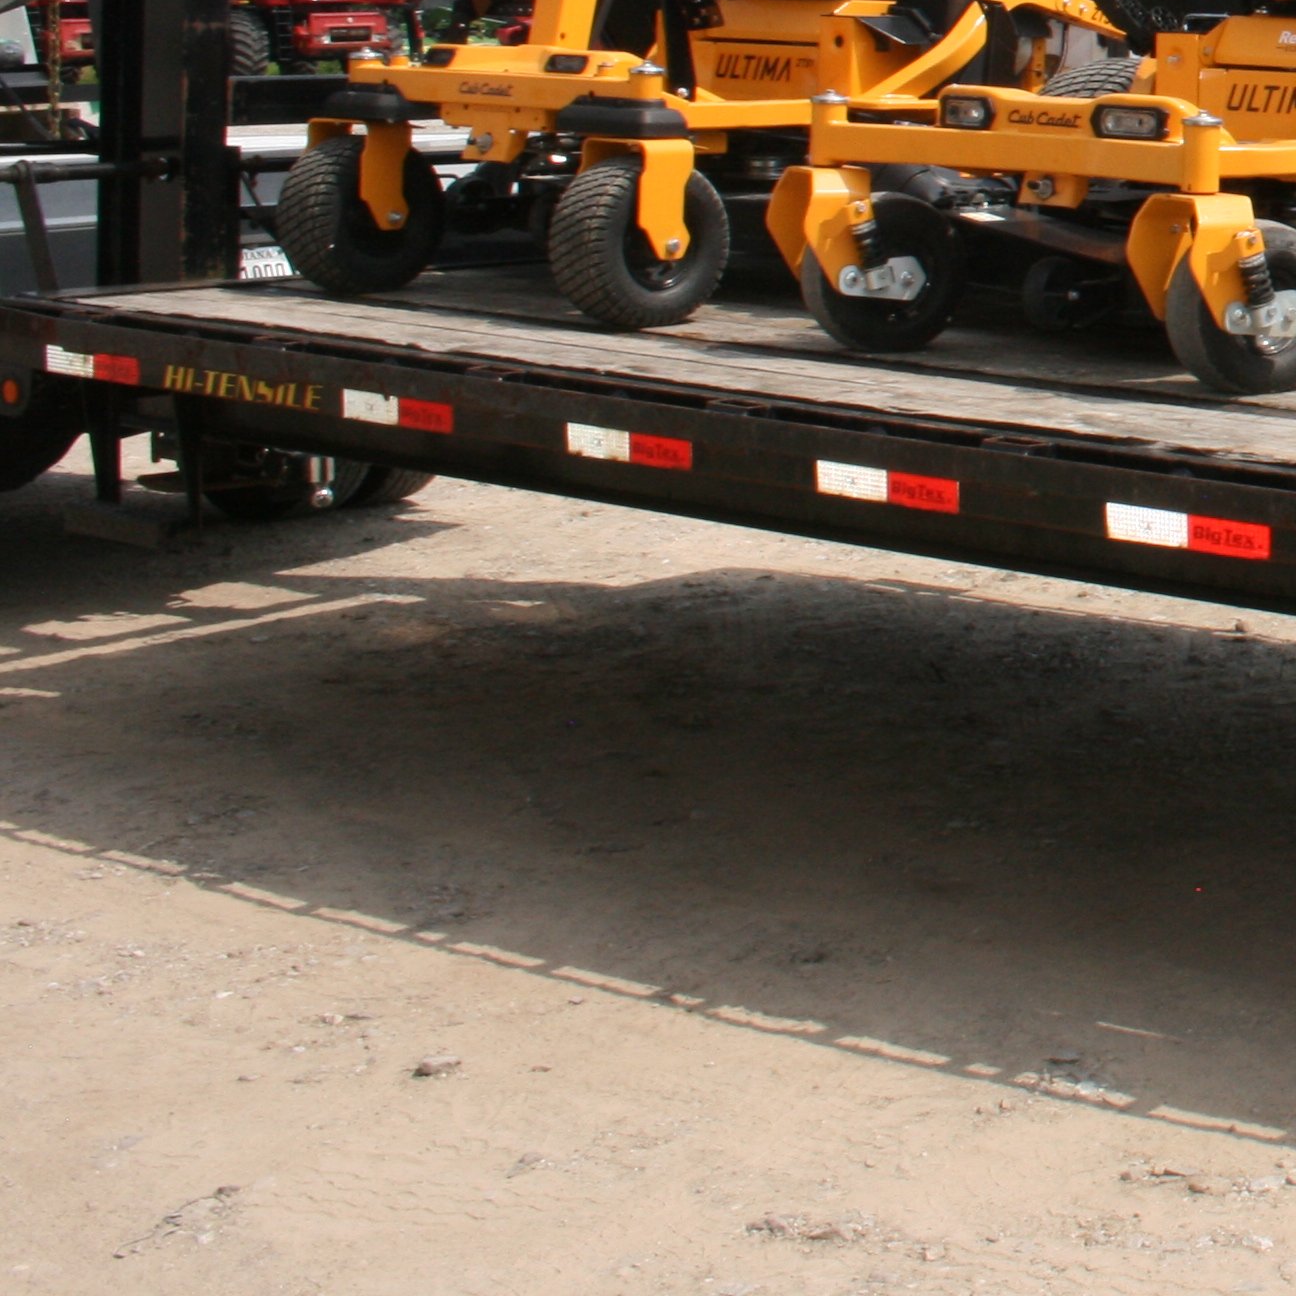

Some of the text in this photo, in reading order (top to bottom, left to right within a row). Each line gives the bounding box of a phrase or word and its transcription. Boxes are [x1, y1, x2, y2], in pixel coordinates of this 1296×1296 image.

[715, 54, 791, 82] ULTIMA
[1008, 109, 1082, 128] Cub Cadet
[163, 364, 324, 412] HI-TENSILE
